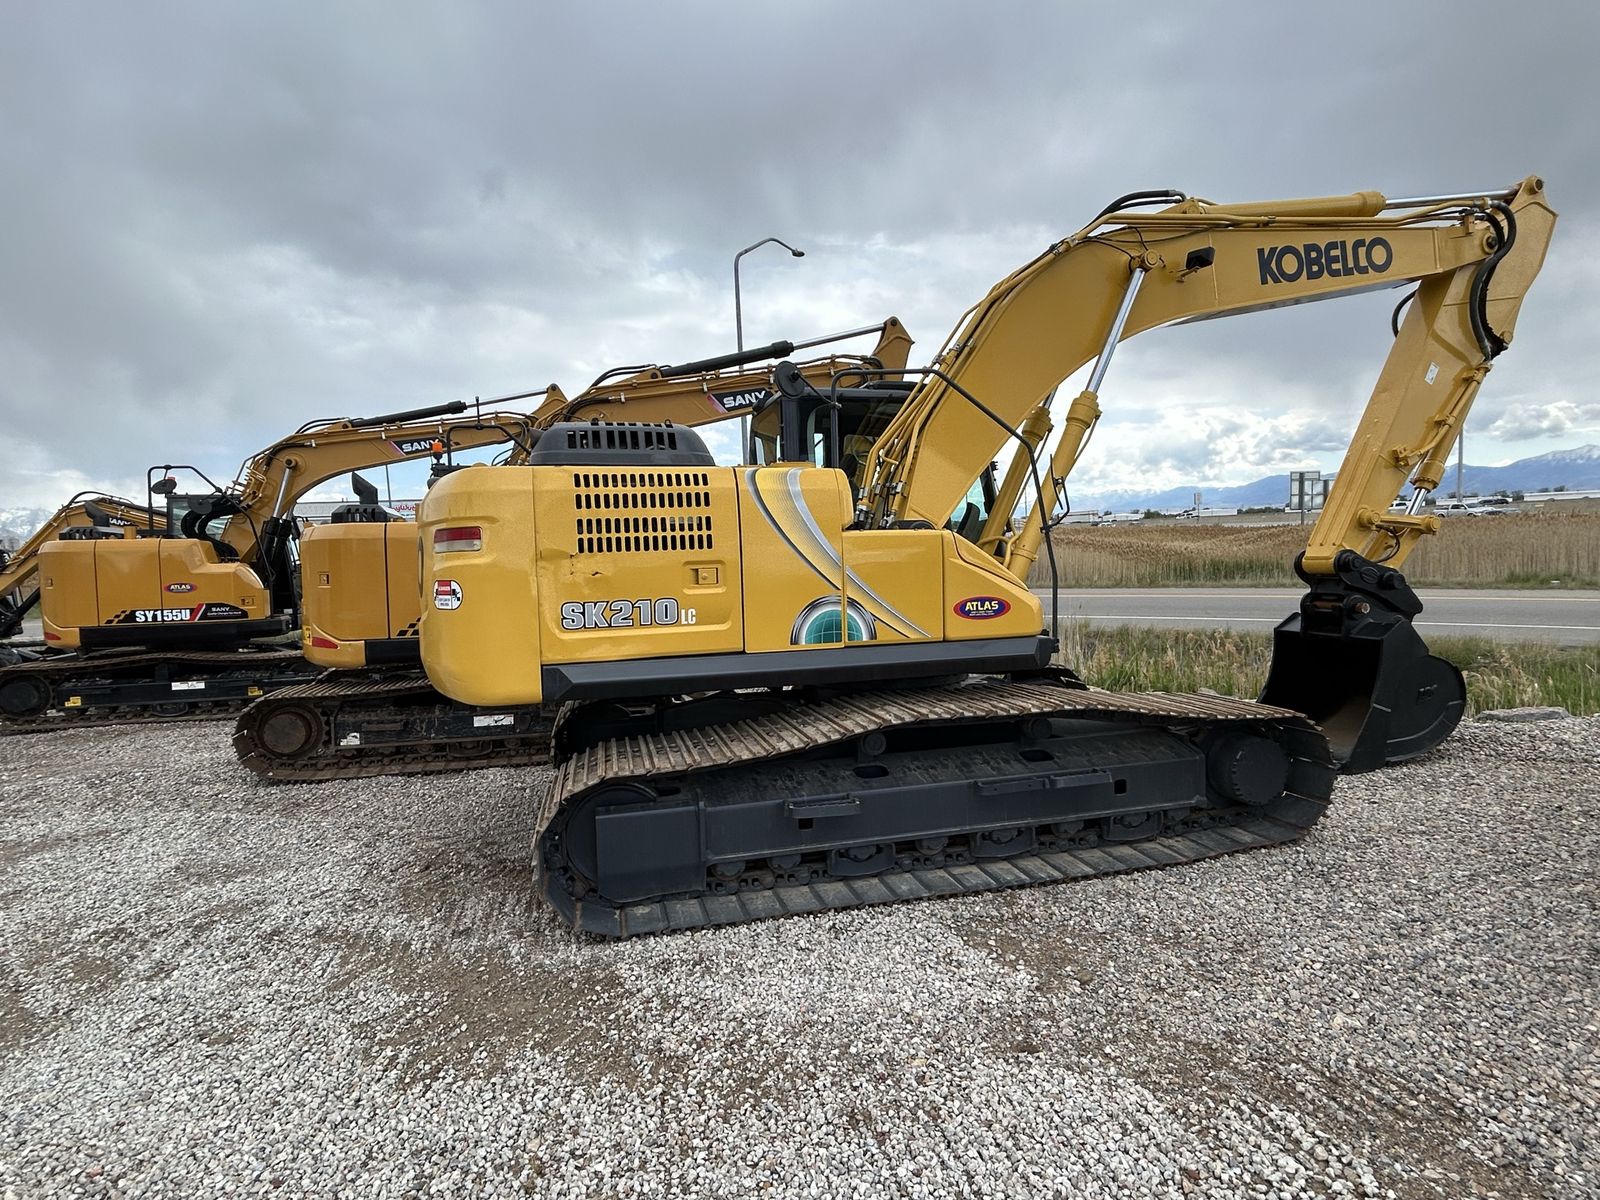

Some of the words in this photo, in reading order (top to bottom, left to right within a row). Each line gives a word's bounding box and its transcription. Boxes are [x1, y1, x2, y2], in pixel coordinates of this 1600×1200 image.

[1257, 237, 1393, 286] KOBELCO
[723, 390, 766, 408] SANY
[561, 597, 679, 630] SK210
[681, 608, 697, 625] LC
[965, 600, 999, 611] ATLAS
[135, 609, 190, 622] SY155U
